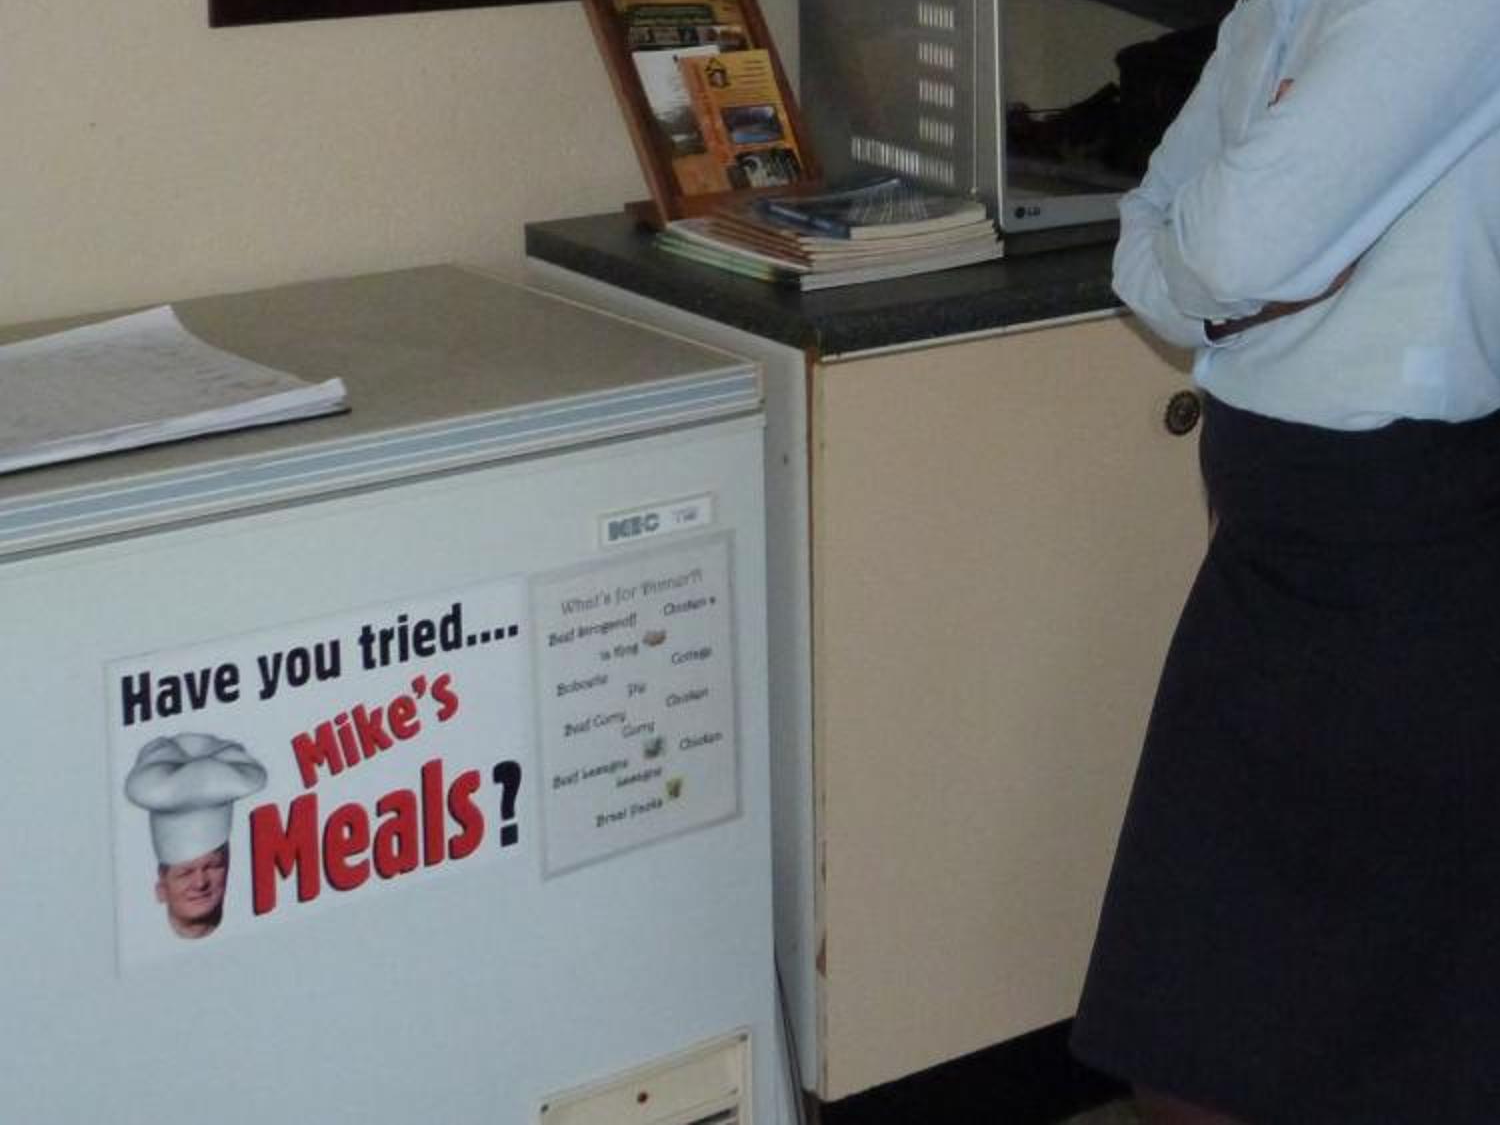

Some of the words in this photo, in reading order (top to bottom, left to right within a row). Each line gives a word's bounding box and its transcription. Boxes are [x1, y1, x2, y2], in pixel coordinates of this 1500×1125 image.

[614, 586, 638, 606] for
[121, 659, 241, 727] Have
[257, 637, 342, 700] you
[358, 601, 520, 672] tried....
[290, 671, 460, 789] Mike's
[248, 759, 523, 917] Meals?
